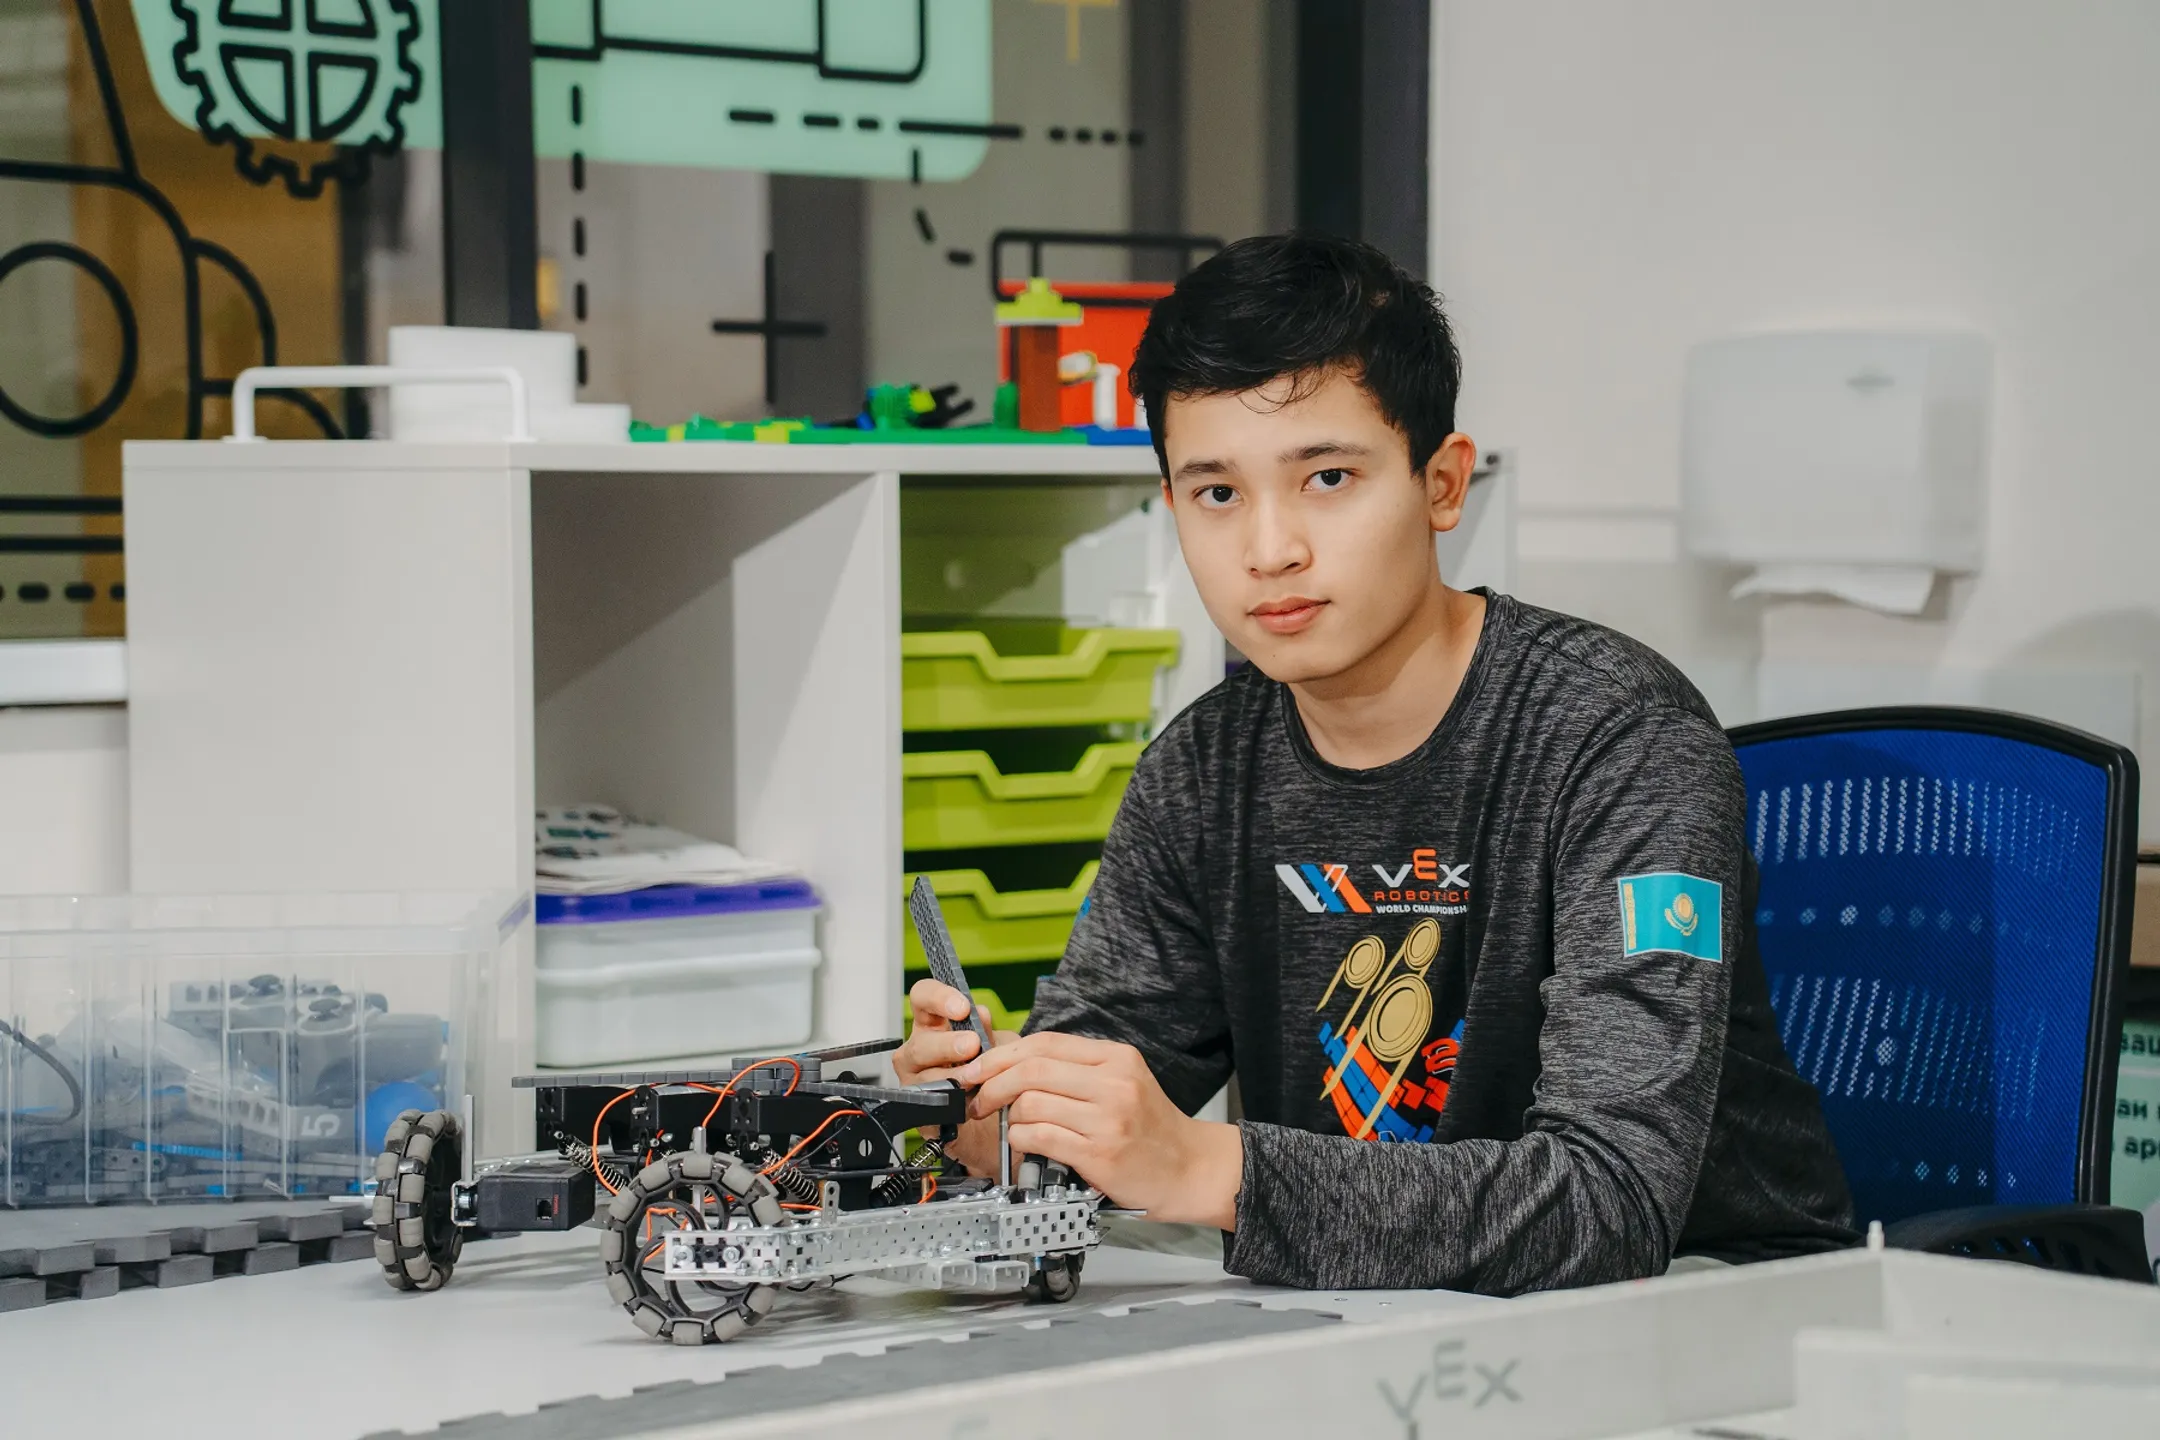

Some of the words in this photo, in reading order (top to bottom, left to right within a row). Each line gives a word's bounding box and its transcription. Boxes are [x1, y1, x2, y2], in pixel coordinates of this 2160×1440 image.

[1372, 848, 1470, 888] VEX
[1376, 904, 1411, 914] WORLD
[2123, 1136, 2160, 1162] ар
